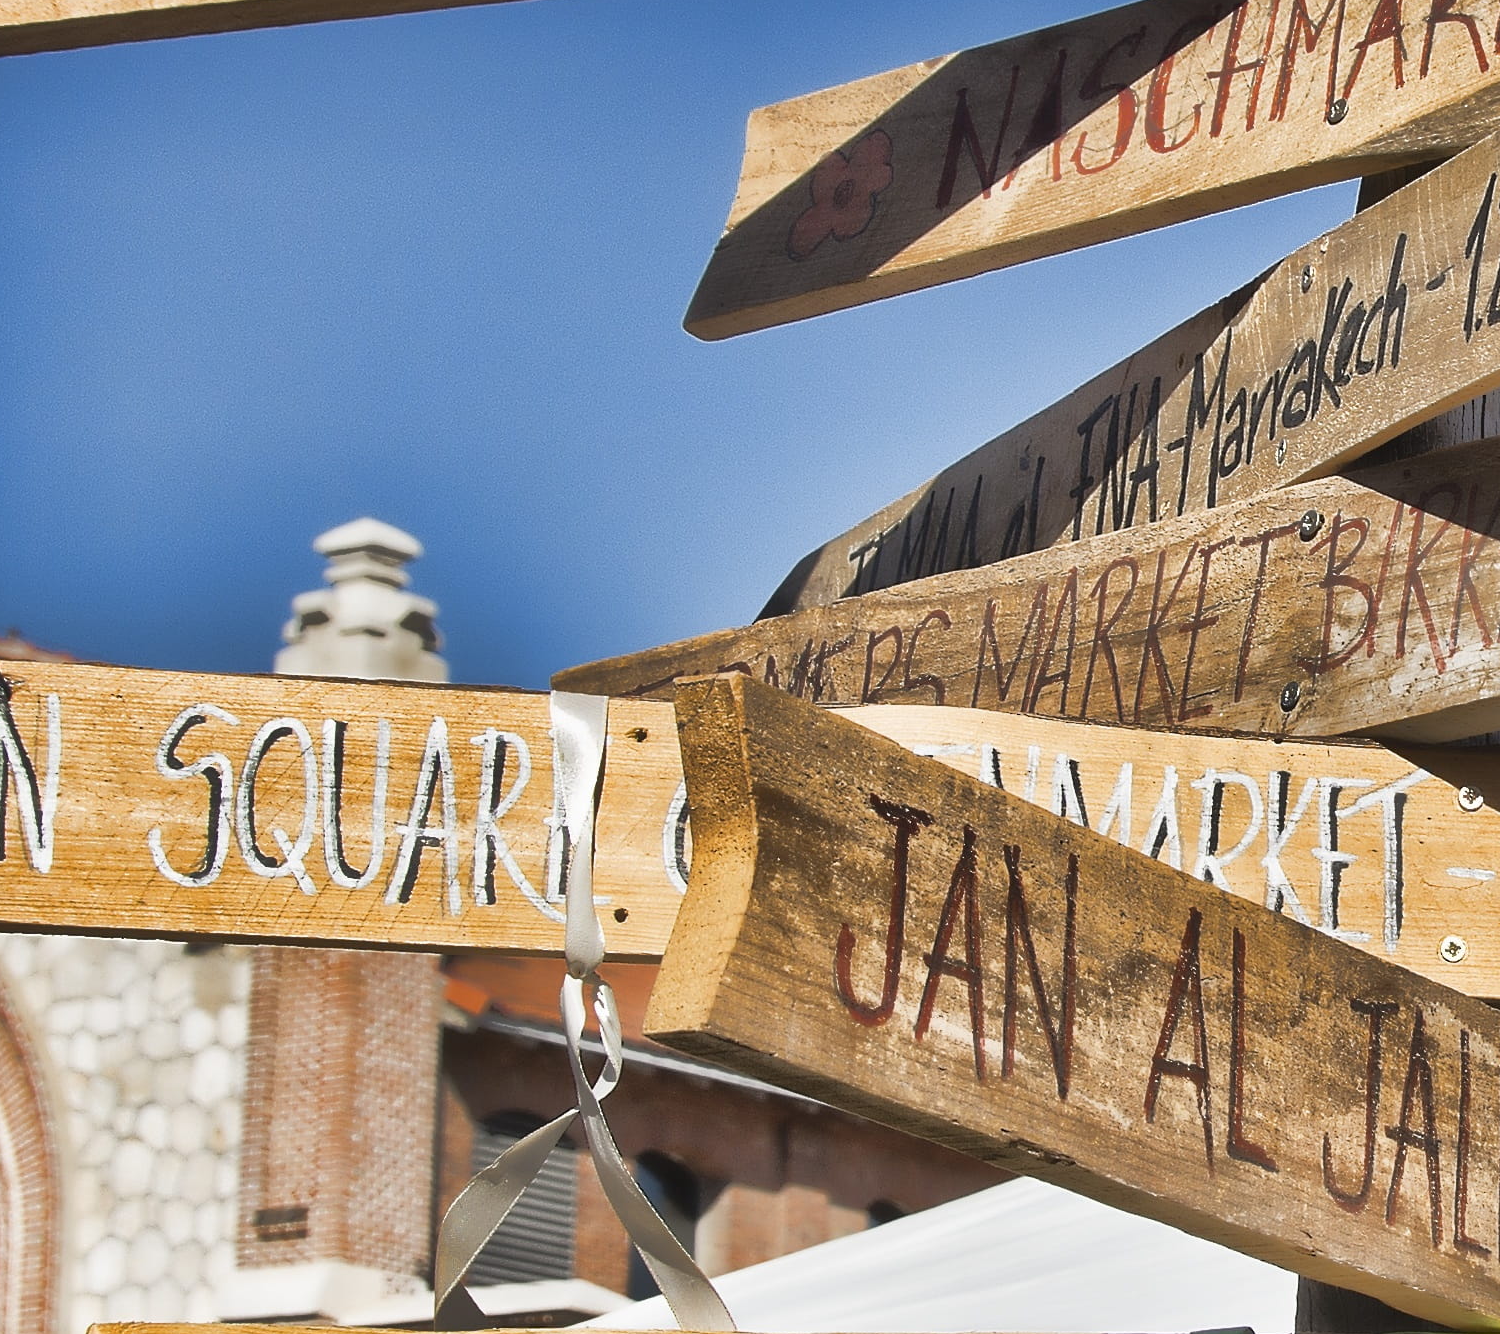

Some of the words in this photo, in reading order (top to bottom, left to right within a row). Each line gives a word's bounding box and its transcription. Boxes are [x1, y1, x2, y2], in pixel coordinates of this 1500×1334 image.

[970, 521, 1300, 725] MARKET
[833, 791, 1080, 1102] JAN
[1143, 903, 1280, 1175] AL
